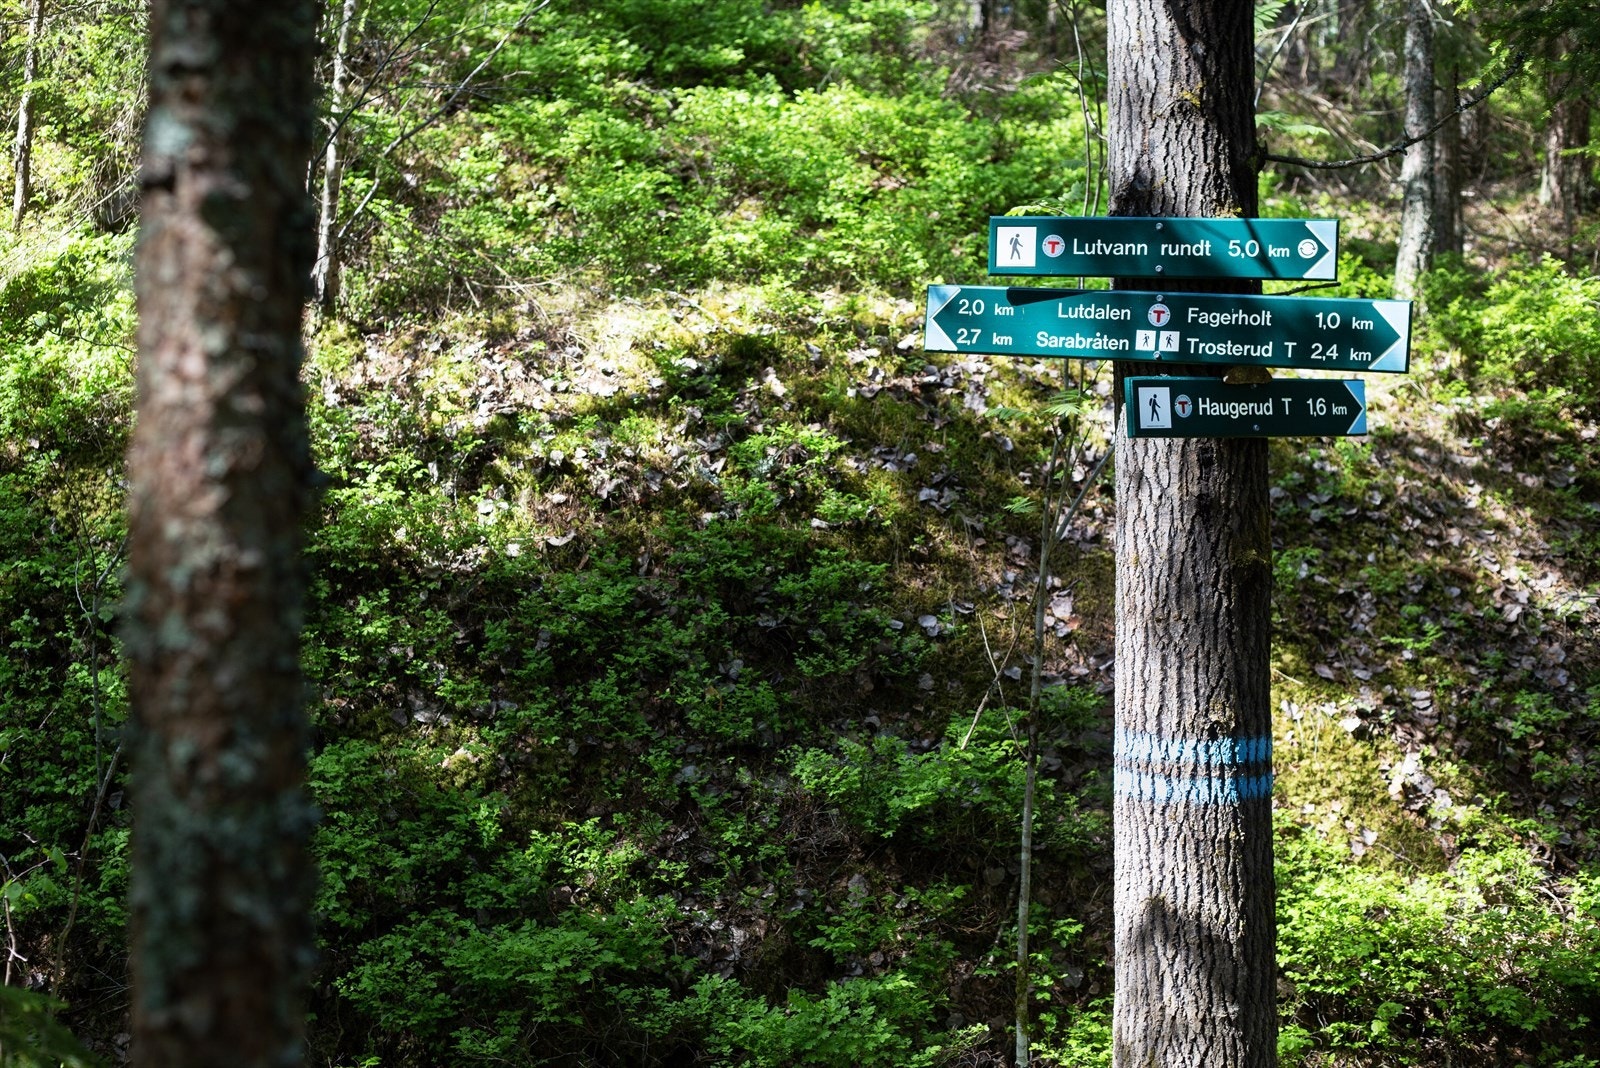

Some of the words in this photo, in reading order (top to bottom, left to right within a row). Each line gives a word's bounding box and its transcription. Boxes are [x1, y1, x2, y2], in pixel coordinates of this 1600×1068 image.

[1074, 239, 1147, 255] Lutvann
[1161, 240, 1211, 256] rundt
[1228, 240, 1259, 258] 5,0
[1269, 245, 1289, 257] km
[959, 299, 984, 316] 2,0
[995, 303, 1014, 315] km
[1058, 303, 1130, 320] Lutdalen
[1188, 308, 1271, 327] Fagerholt
[1316, 312, 1340, 330] 1,0
[1352, 317, 1373, 330] km
[956, 328, 982, 346] 2,7
[993, 333, 1012, 345] km
[1036, 331, 1129, 350] Sarabråten
[1187, 338, 1272, 357] Trosterud
[1284, 342, 1297, 357] T
[1311, 343, 1338, 360] 2,4
[1349, 347, 1372, 361] km
[1199, 398, 1272, 418] Haugerud
[1282, 398, 1291, 414] T
[1307, 398, 1326, 416] 1,6
[1332, 403, 1347, 414] km
